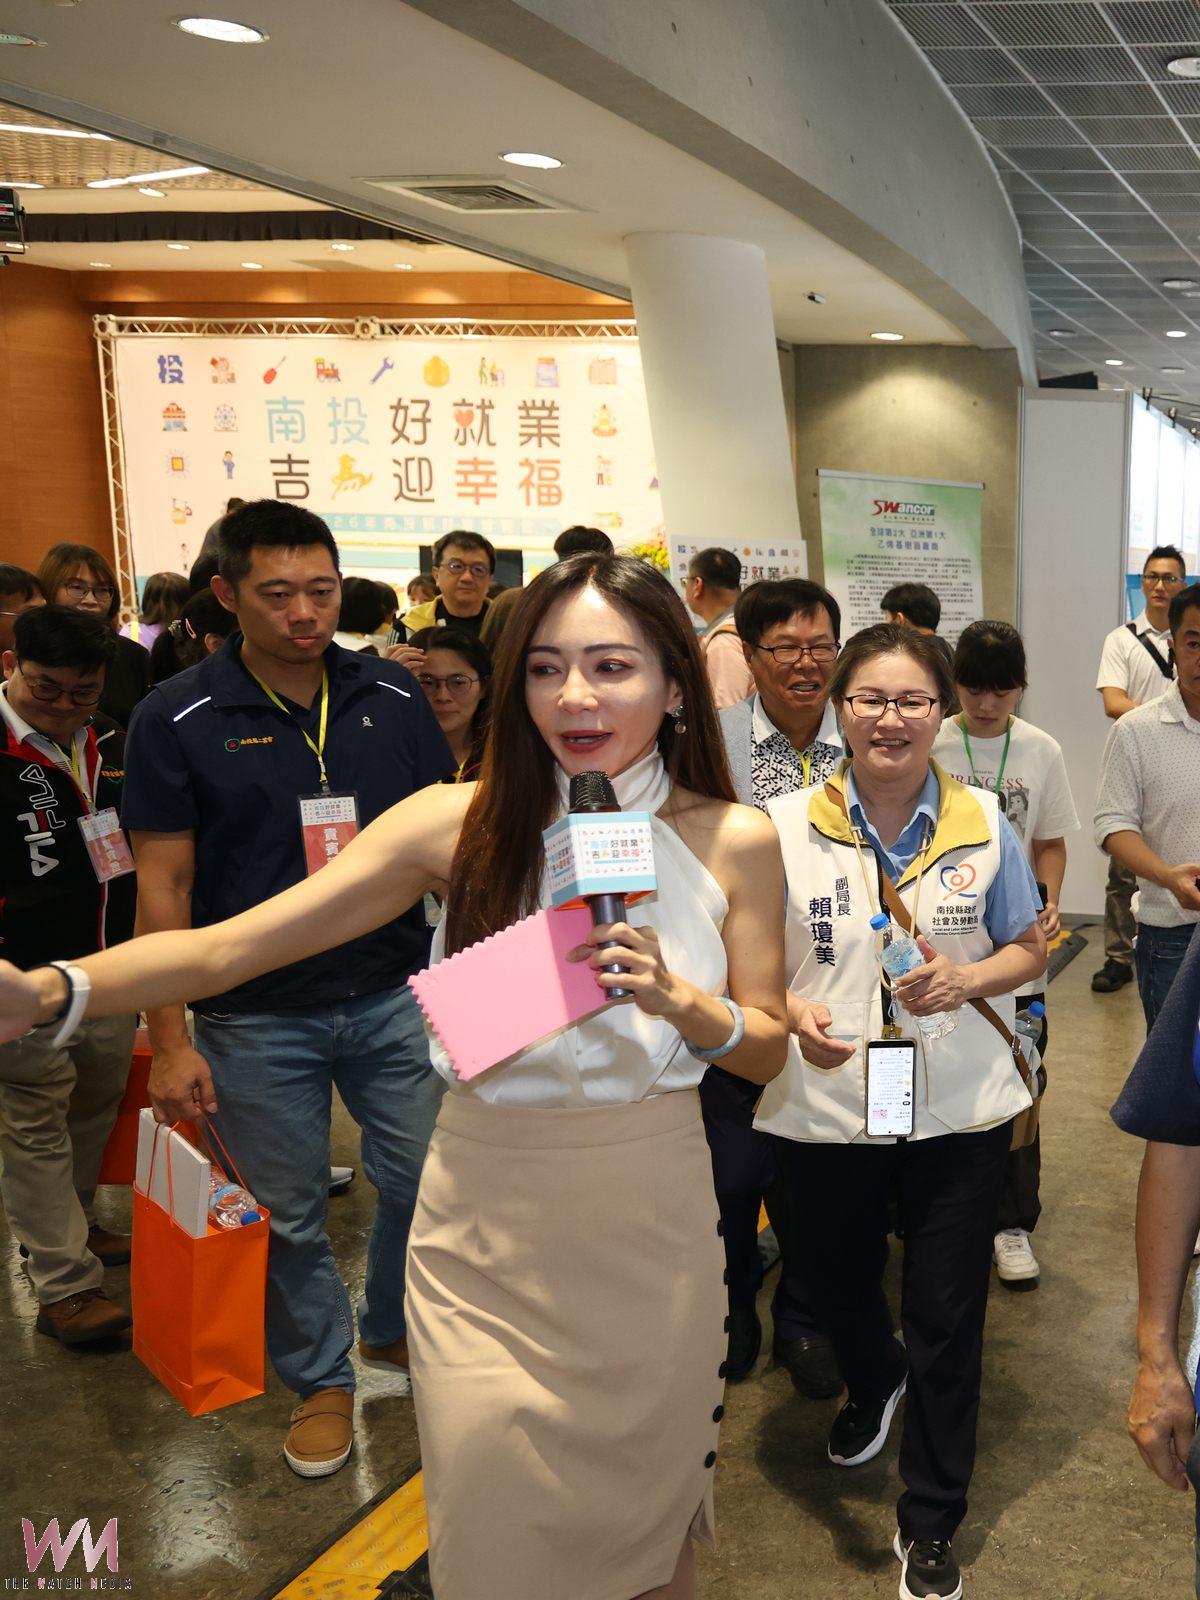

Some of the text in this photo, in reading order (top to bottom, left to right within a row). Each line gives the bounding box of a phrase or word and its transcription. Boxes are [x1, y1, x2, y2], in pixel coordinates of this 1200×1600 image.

[264, 396, 562, 449] 南投好就業
[946, 772, 1025, 792] RINCESS
[835, 875, 852, 917] 副局長
[808, 896, 836, 967] 賴瓊美
